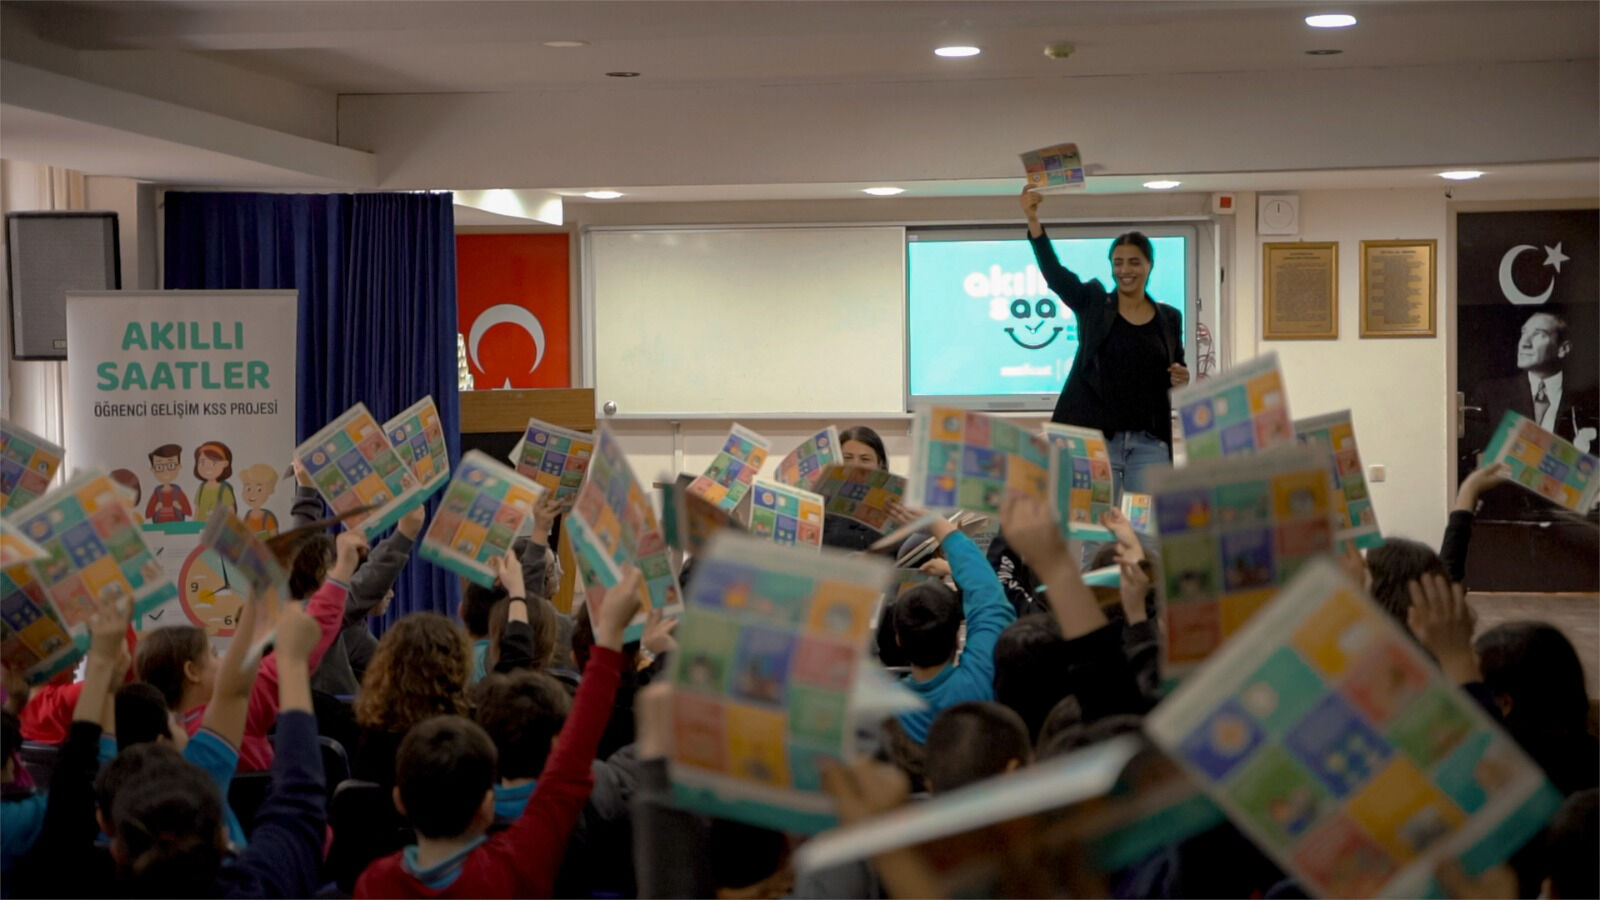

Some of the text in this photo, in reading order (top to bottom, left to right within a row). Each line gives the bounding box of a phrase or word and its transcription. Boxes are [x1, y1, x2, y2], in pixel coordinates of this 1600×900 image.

[121, 321, 243, 350] AKILLI
[96, 361, 270, 391] SAATLER
[94, 399, 278, 418] ÖĞRENCİ GELİŞİM KSS PROJESİ
[191, 582, 199, 592] 9
[224, 615, 232, 625] 6
